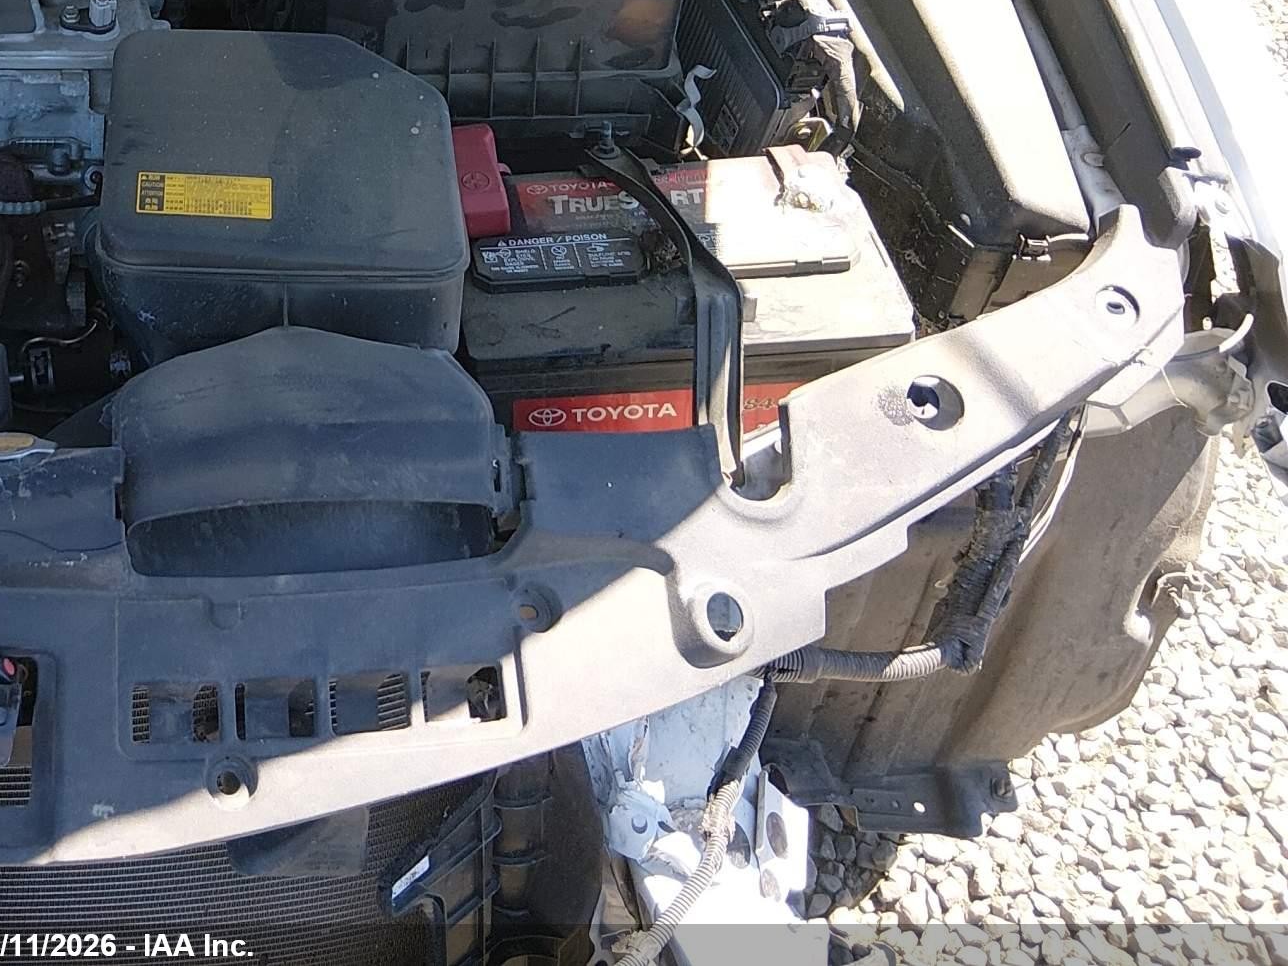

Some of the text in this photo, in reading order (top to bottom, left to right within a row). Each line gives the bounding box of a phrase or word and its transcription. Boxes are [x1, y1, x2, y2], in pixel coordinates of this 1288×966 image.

[549, 181, 607, 192] TOYOTA
[508, 236, 553, 246] DANGER
[565, 234, 607, 242] POISON
[571, 403, 677, 422] TOYOTA
